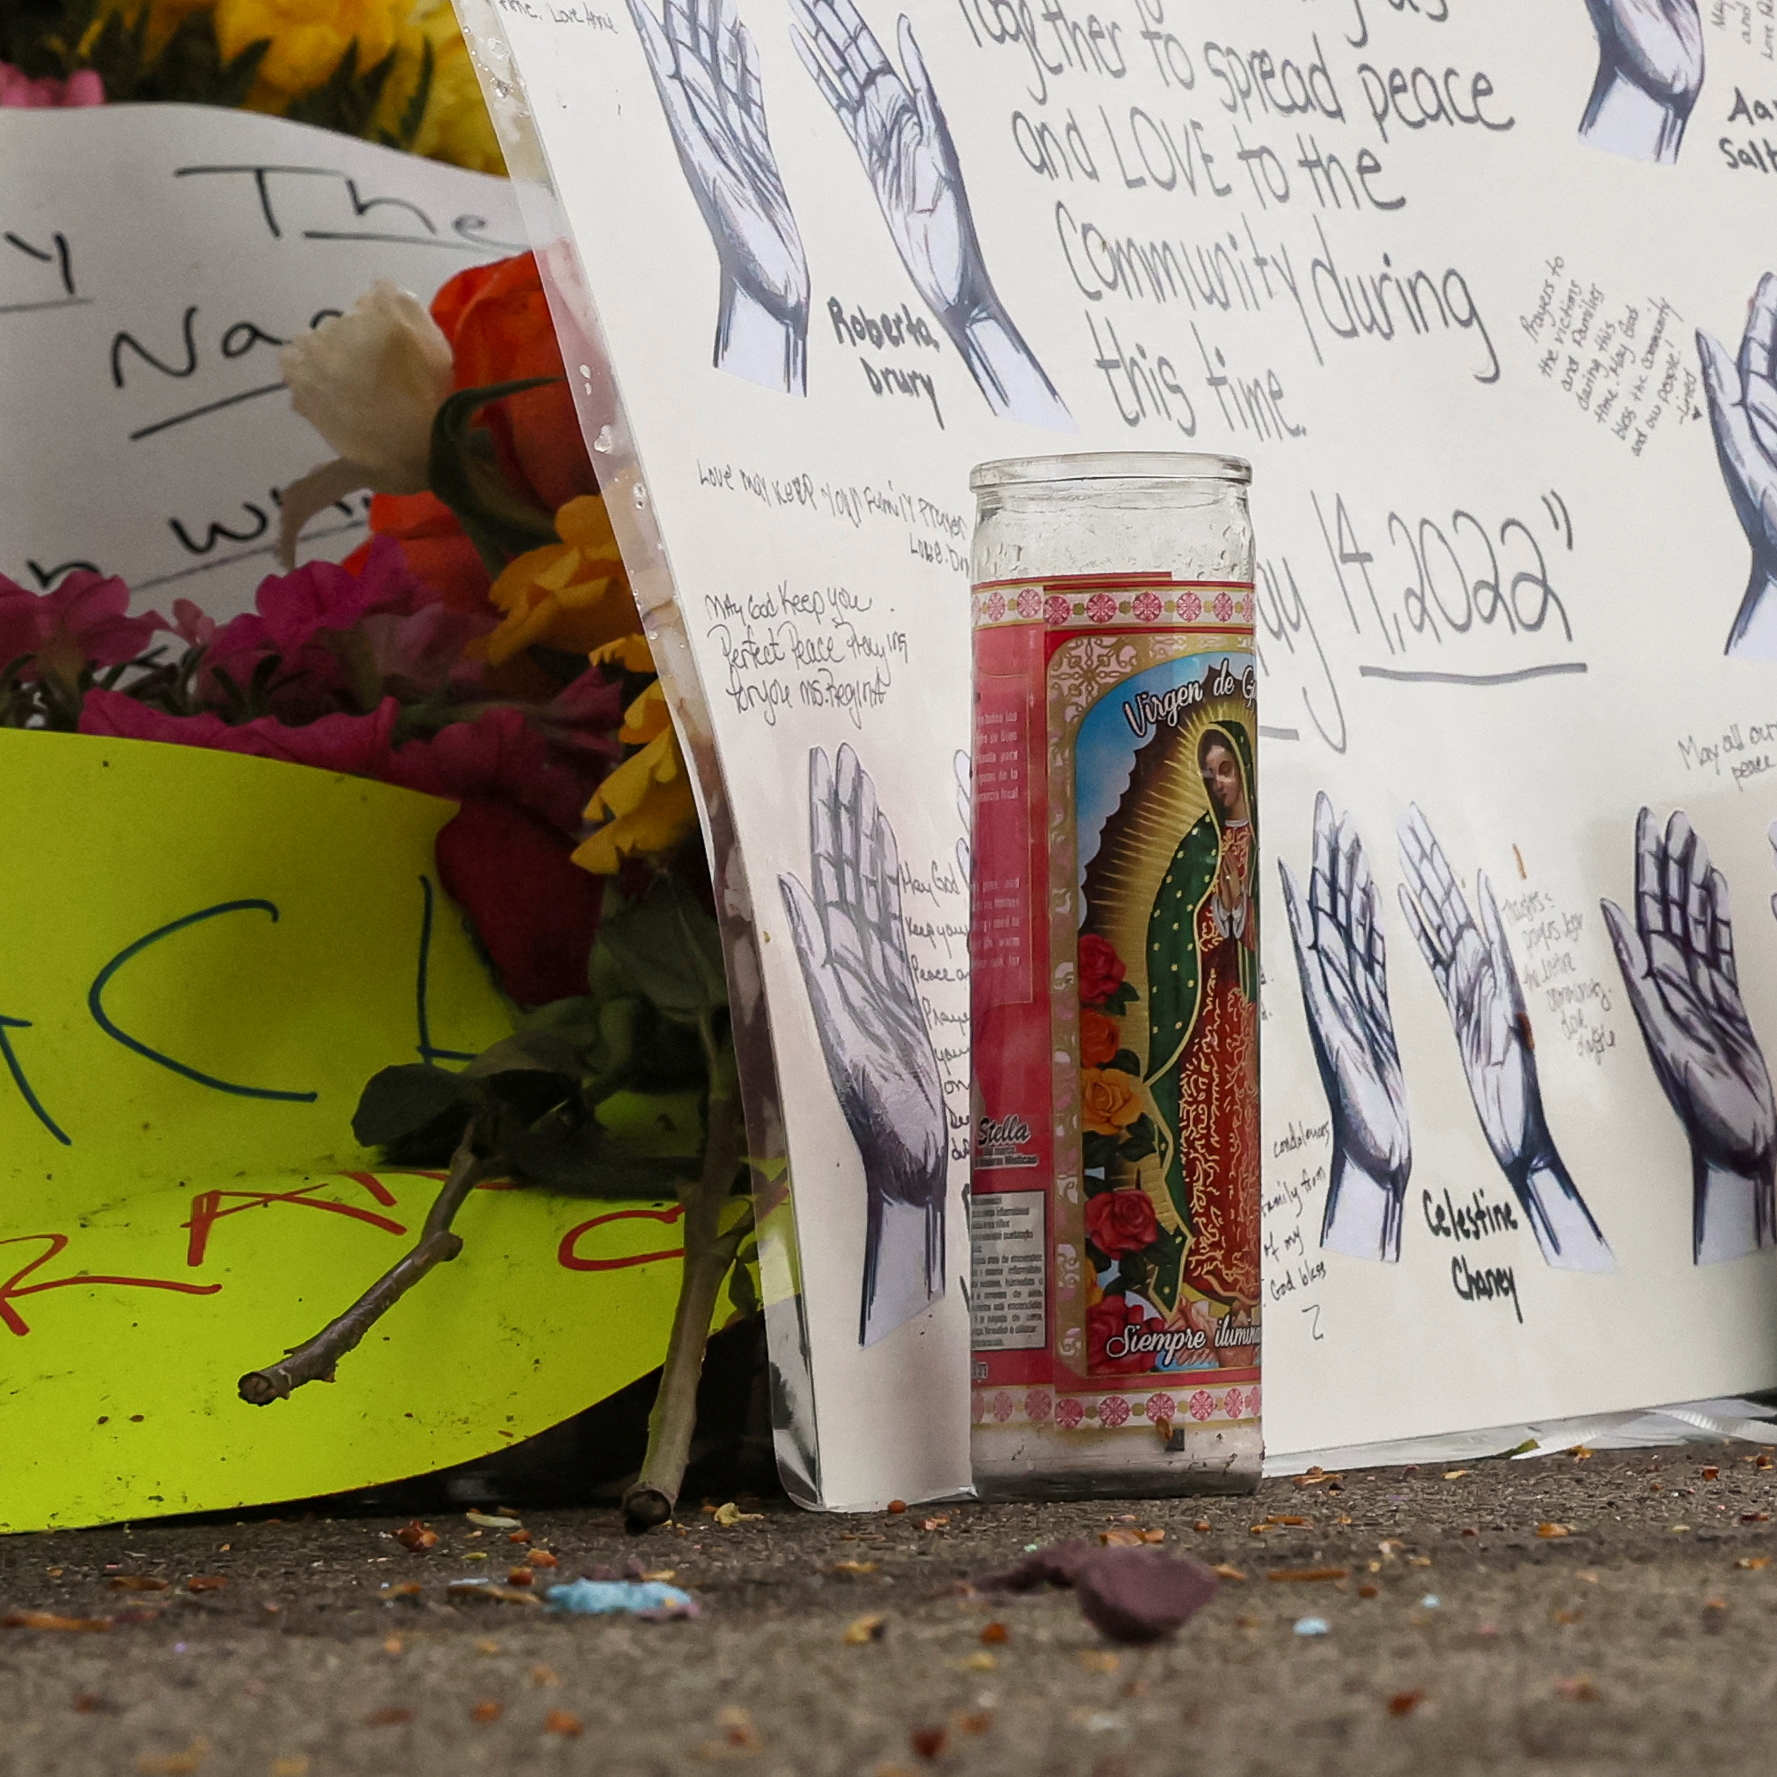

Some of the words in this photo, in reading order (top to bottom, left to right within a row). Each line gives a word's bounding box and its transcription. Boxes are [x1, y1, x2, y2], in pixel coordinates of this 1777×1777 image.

[1203, 33, 1346, 124] spread
[1357, 62, 1514, 144] peace
[1011, 108, 1100, 181] and
[1100, 105, 1233, 197] LOVE
[1232, 125, 1290, 211] to
[1296, 132, 1407, 211] the
[826, 296, 941, 352] Roberta
[1310, 213, 1502, 384] during
[859, 357, 945, 431] Drury
[1085, 310, 1198, 437] this
[1256, 556, 1347, 755] ay
[1123, 681, 1203, 738] Virgen
[1212, 657, 1236, 696] de
[978, 1113, 1032, 1146] Stella
[1422, 1187, 1519, 1243] Celestine
[1451, 1254, 1524, 1325] Chaney
[1106, 1324, 1206, 1366] Siempre
